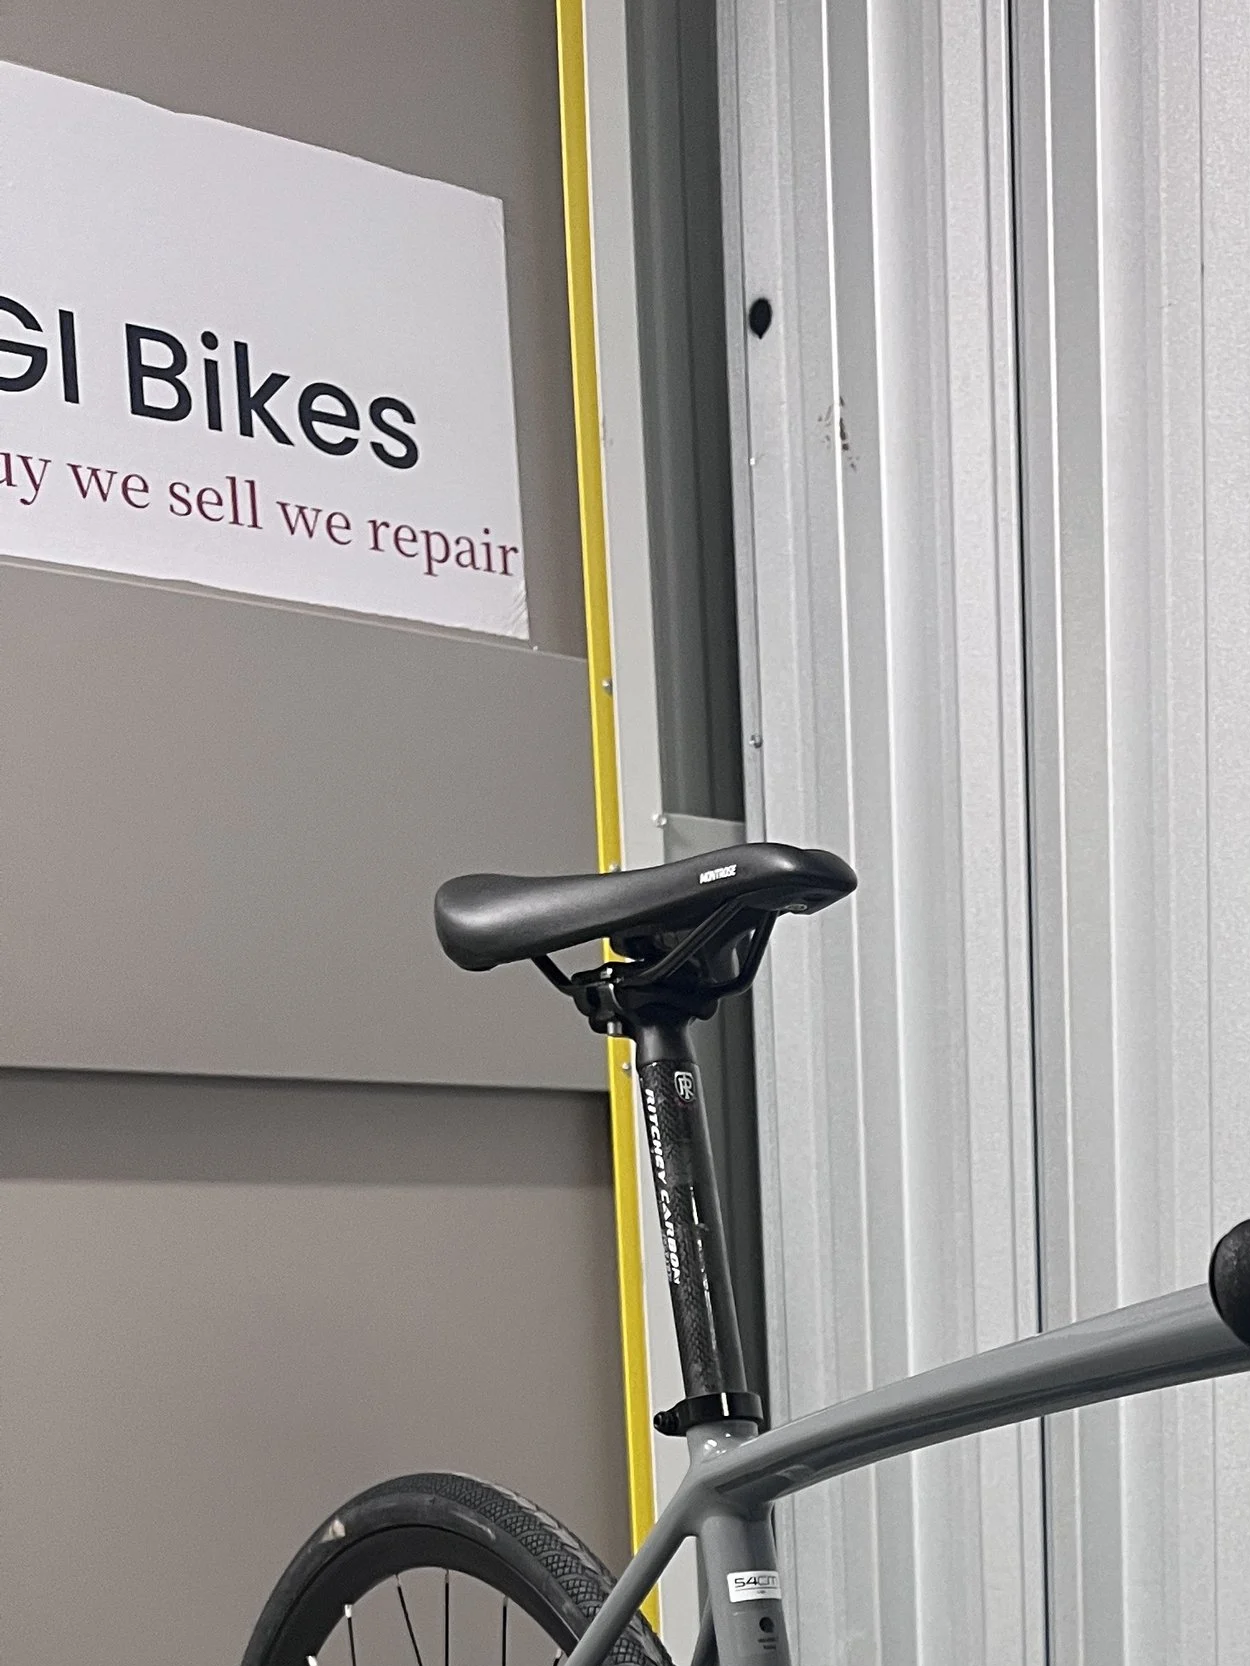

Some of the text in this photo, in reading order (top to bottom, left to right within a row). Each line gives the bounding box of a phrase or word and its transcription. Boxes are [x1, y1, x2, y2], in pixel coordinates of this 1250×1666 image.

[125, 323, 419, 470] Bikes
[67, 462, 151, 509] we
[168, 476, 263, 530] sell
[276, 500, 353, 546] we
[367, 515, 520, 577] repair
[645, 1088, 667, 1184] RITCHEY
[660, 1189, 681, 1285] CARBON
